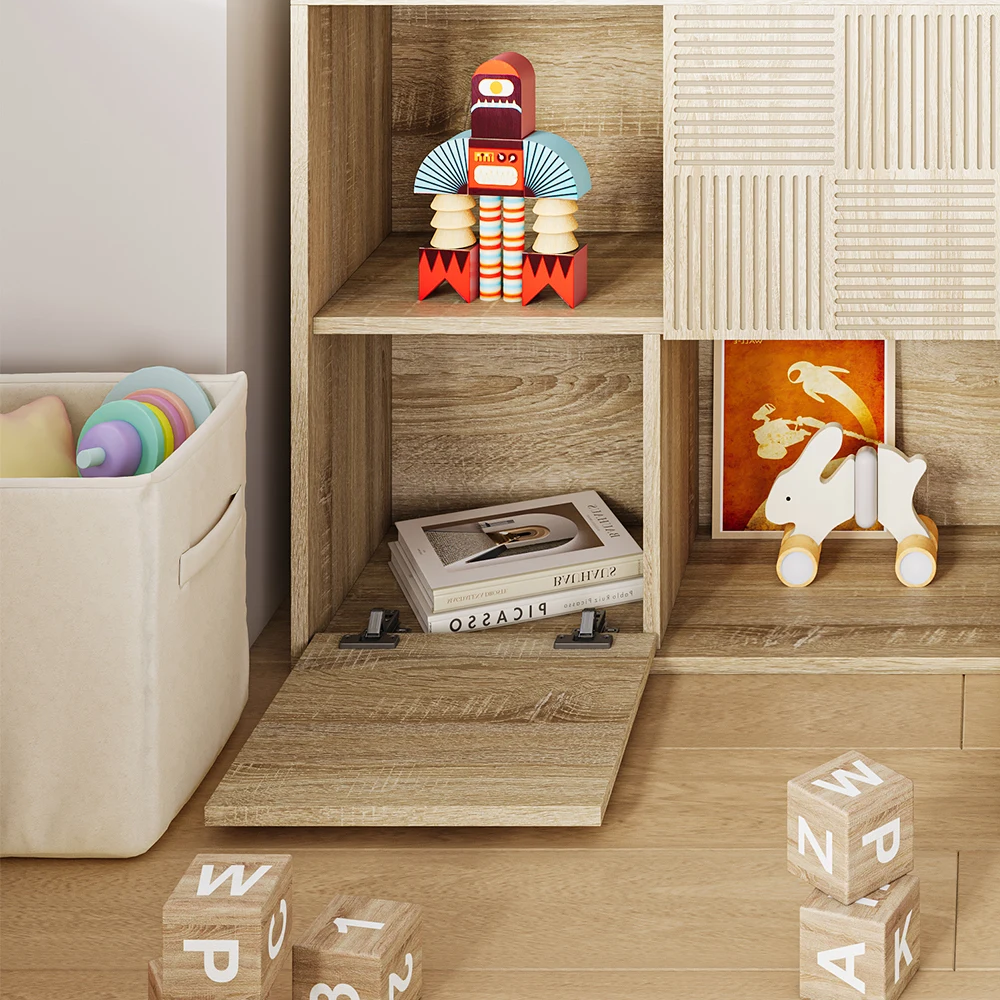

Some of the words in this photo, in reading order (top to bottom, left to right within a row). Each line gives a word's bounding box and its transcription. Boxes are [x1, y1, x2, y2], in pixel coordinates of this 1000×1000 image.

[862, 817, 900, 864] P
[183, 940, 239, 983] P
[817, 942, 866, 995] A
[894, 909, 913, 984] K
